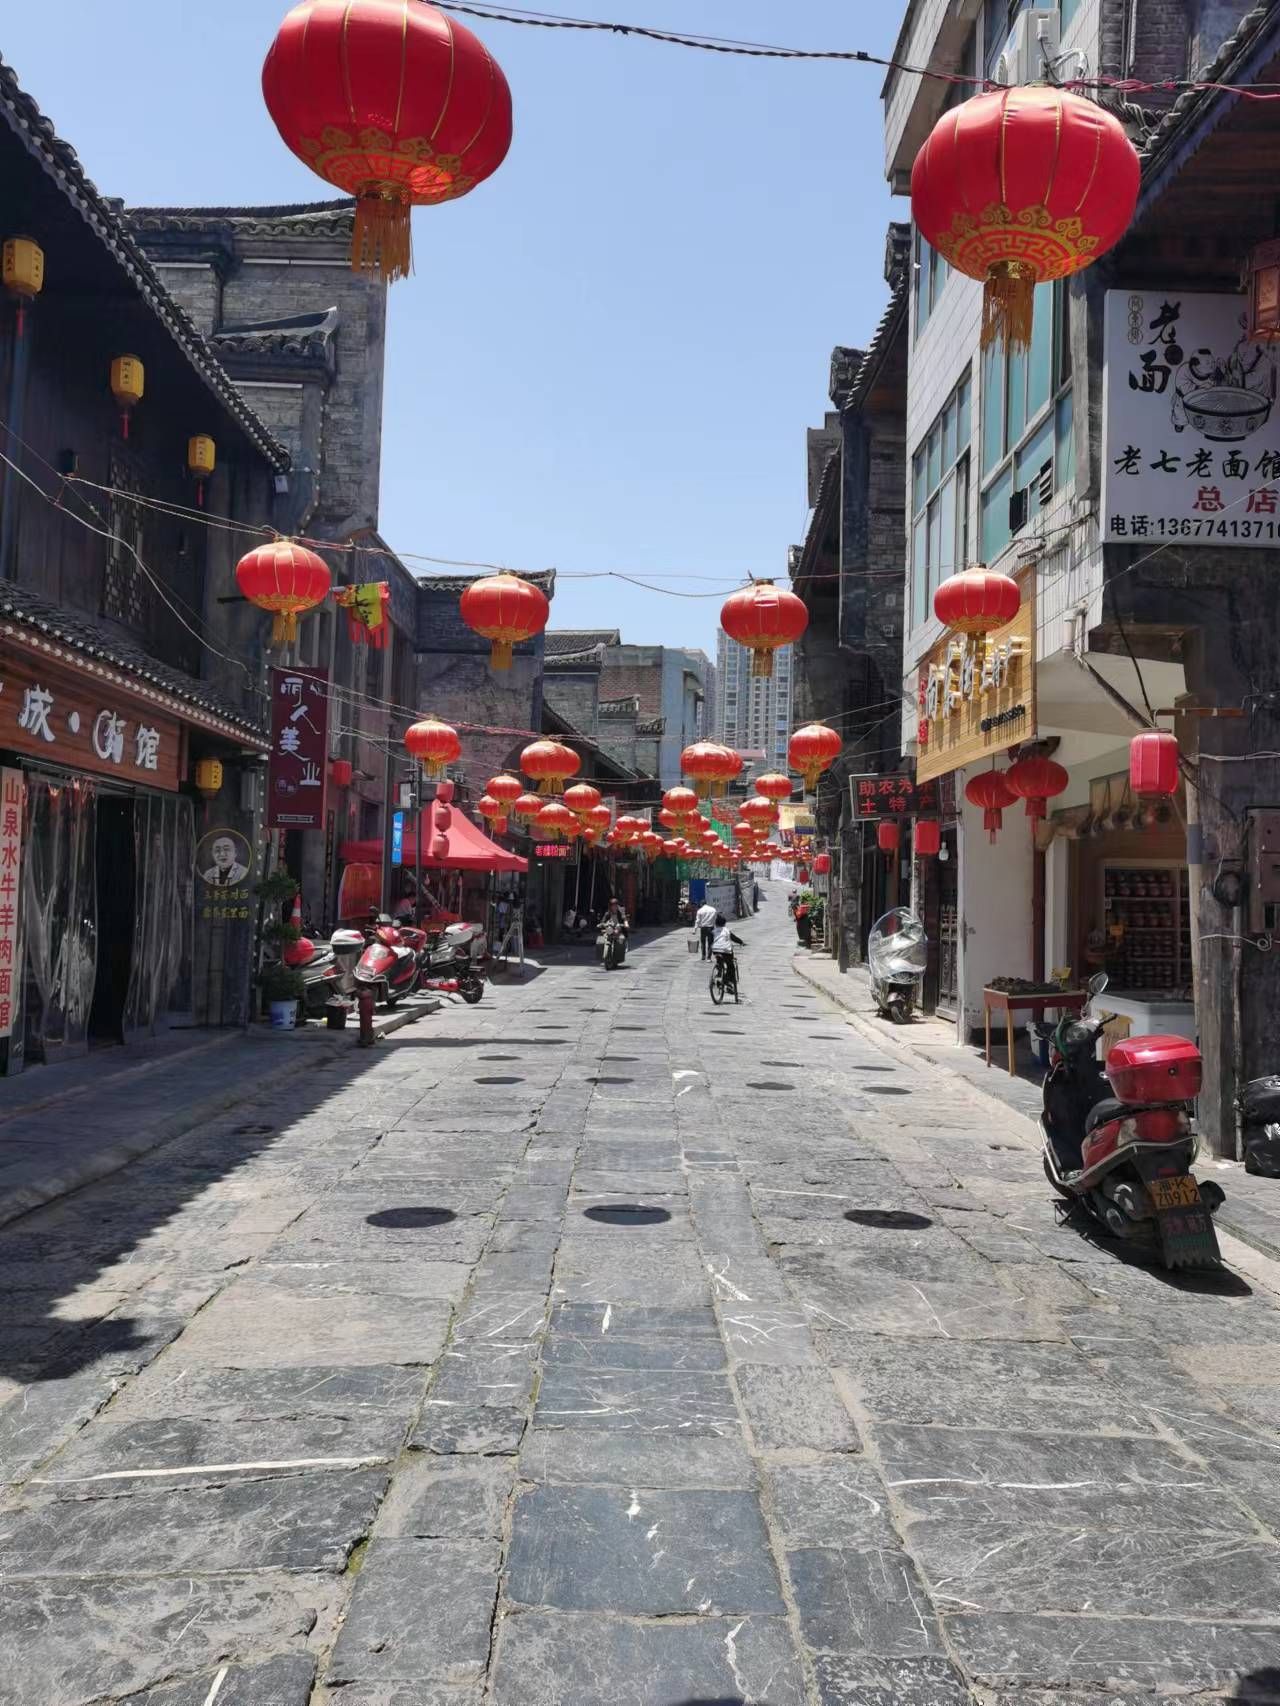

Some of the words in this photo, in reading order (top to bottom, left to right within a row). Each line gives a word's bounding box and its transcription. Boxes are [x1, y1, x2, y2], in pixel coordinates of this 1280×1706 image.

[1113, 445, 1280, 481] 老七老面馆
[1192, 486, 1278, 514] 总店
